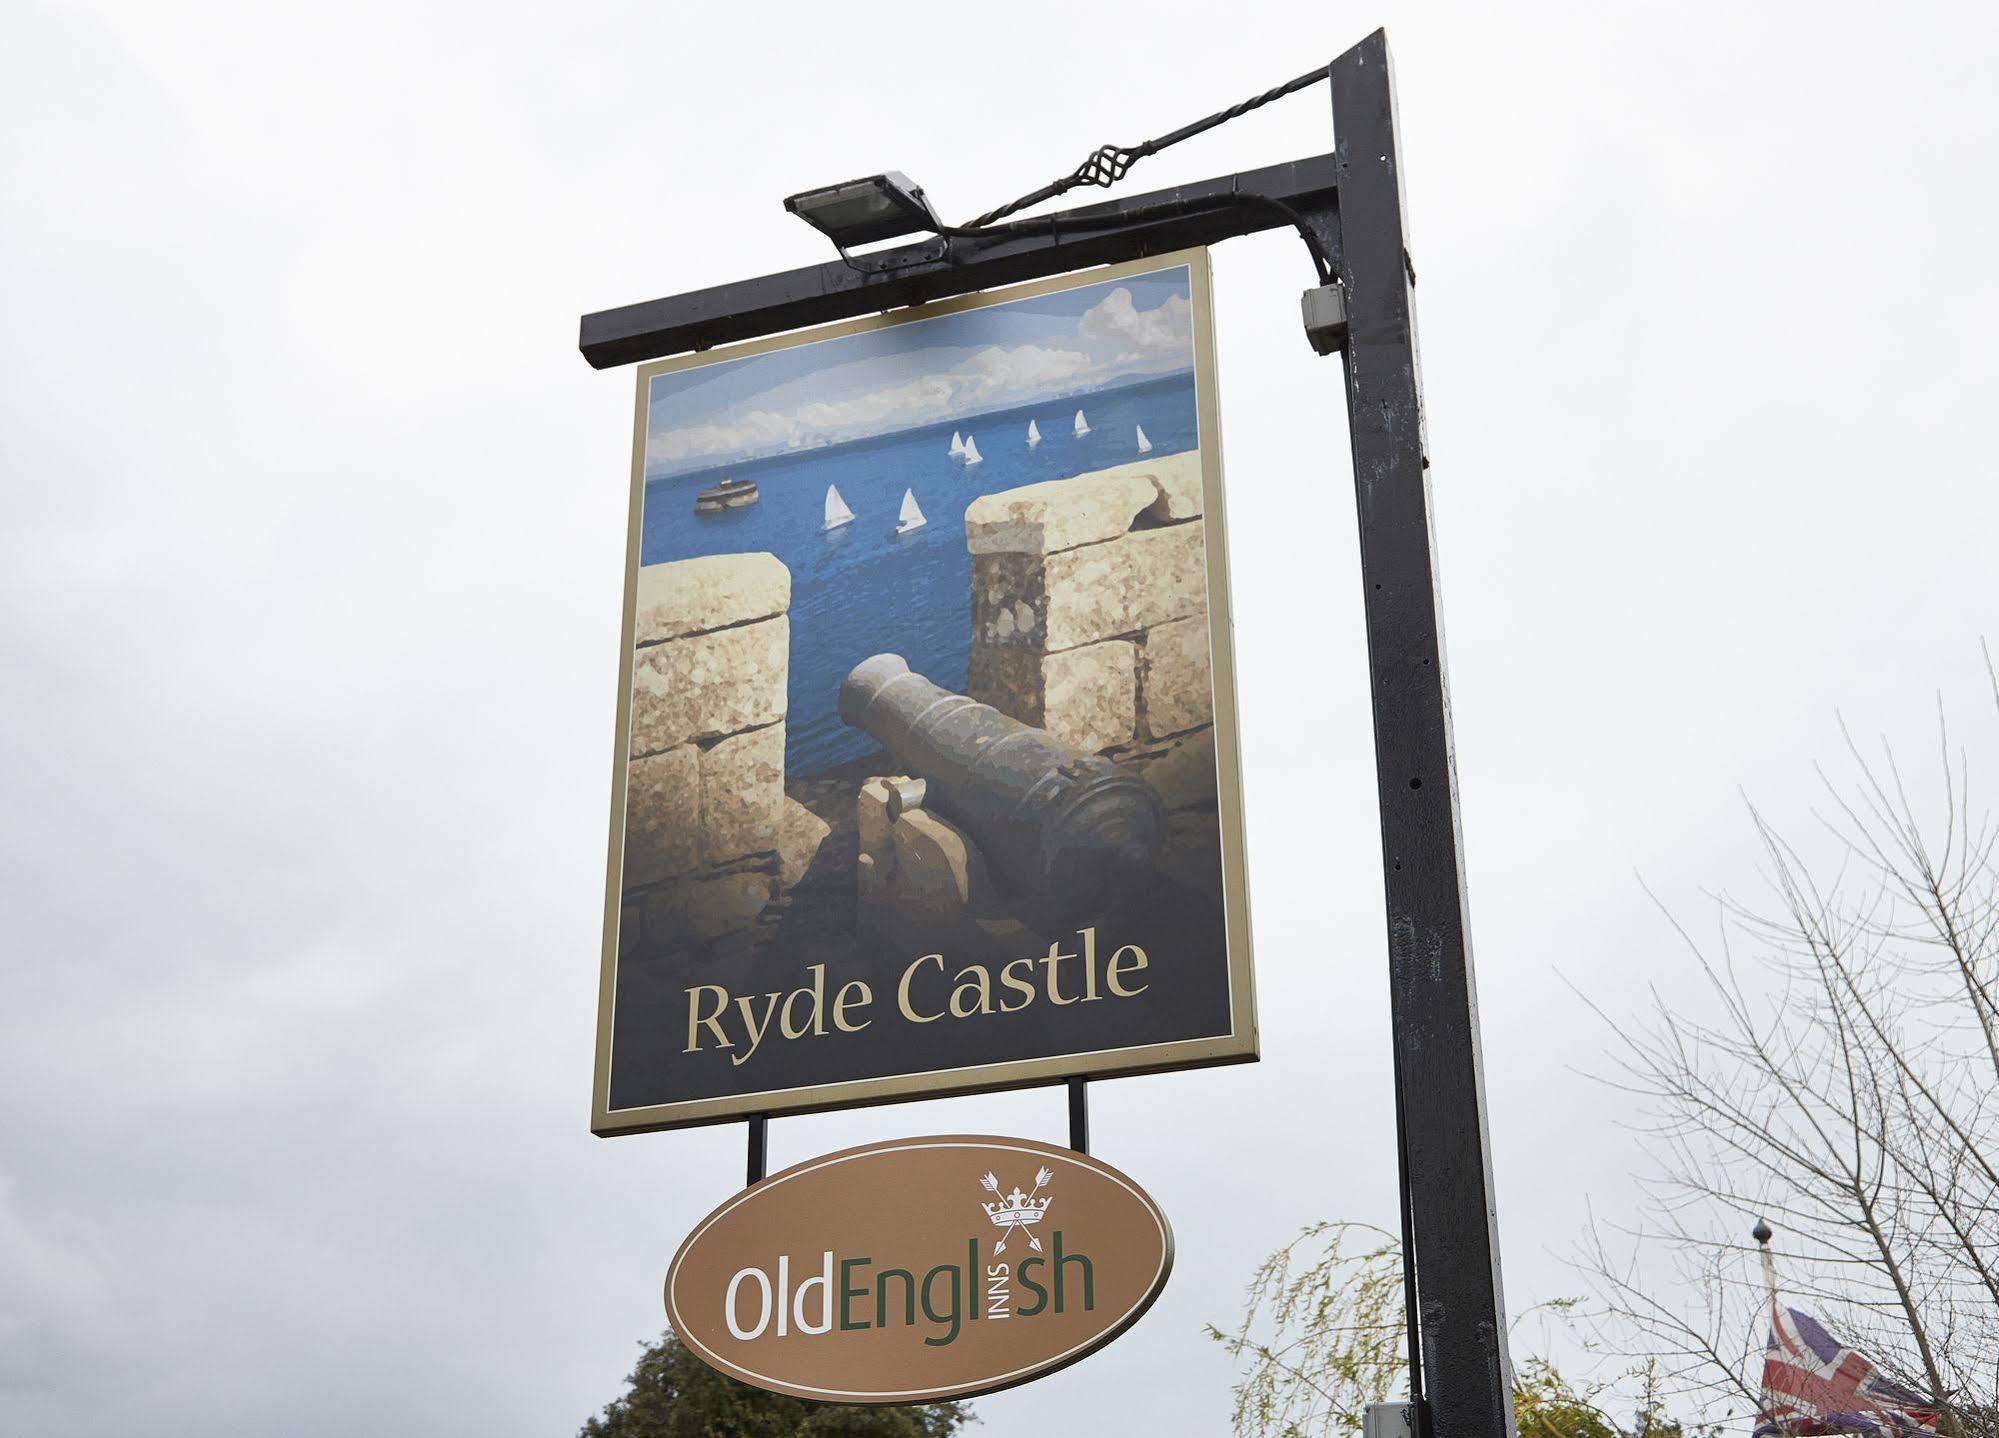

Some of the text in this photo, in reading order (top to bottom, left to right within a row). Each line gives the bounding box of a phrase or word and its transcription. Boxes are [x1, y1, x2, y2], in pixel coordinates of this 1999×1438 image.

[682, 927, 1149, 1066] Ryde Castle
[987, 1262, 1010, 1320] INNS
